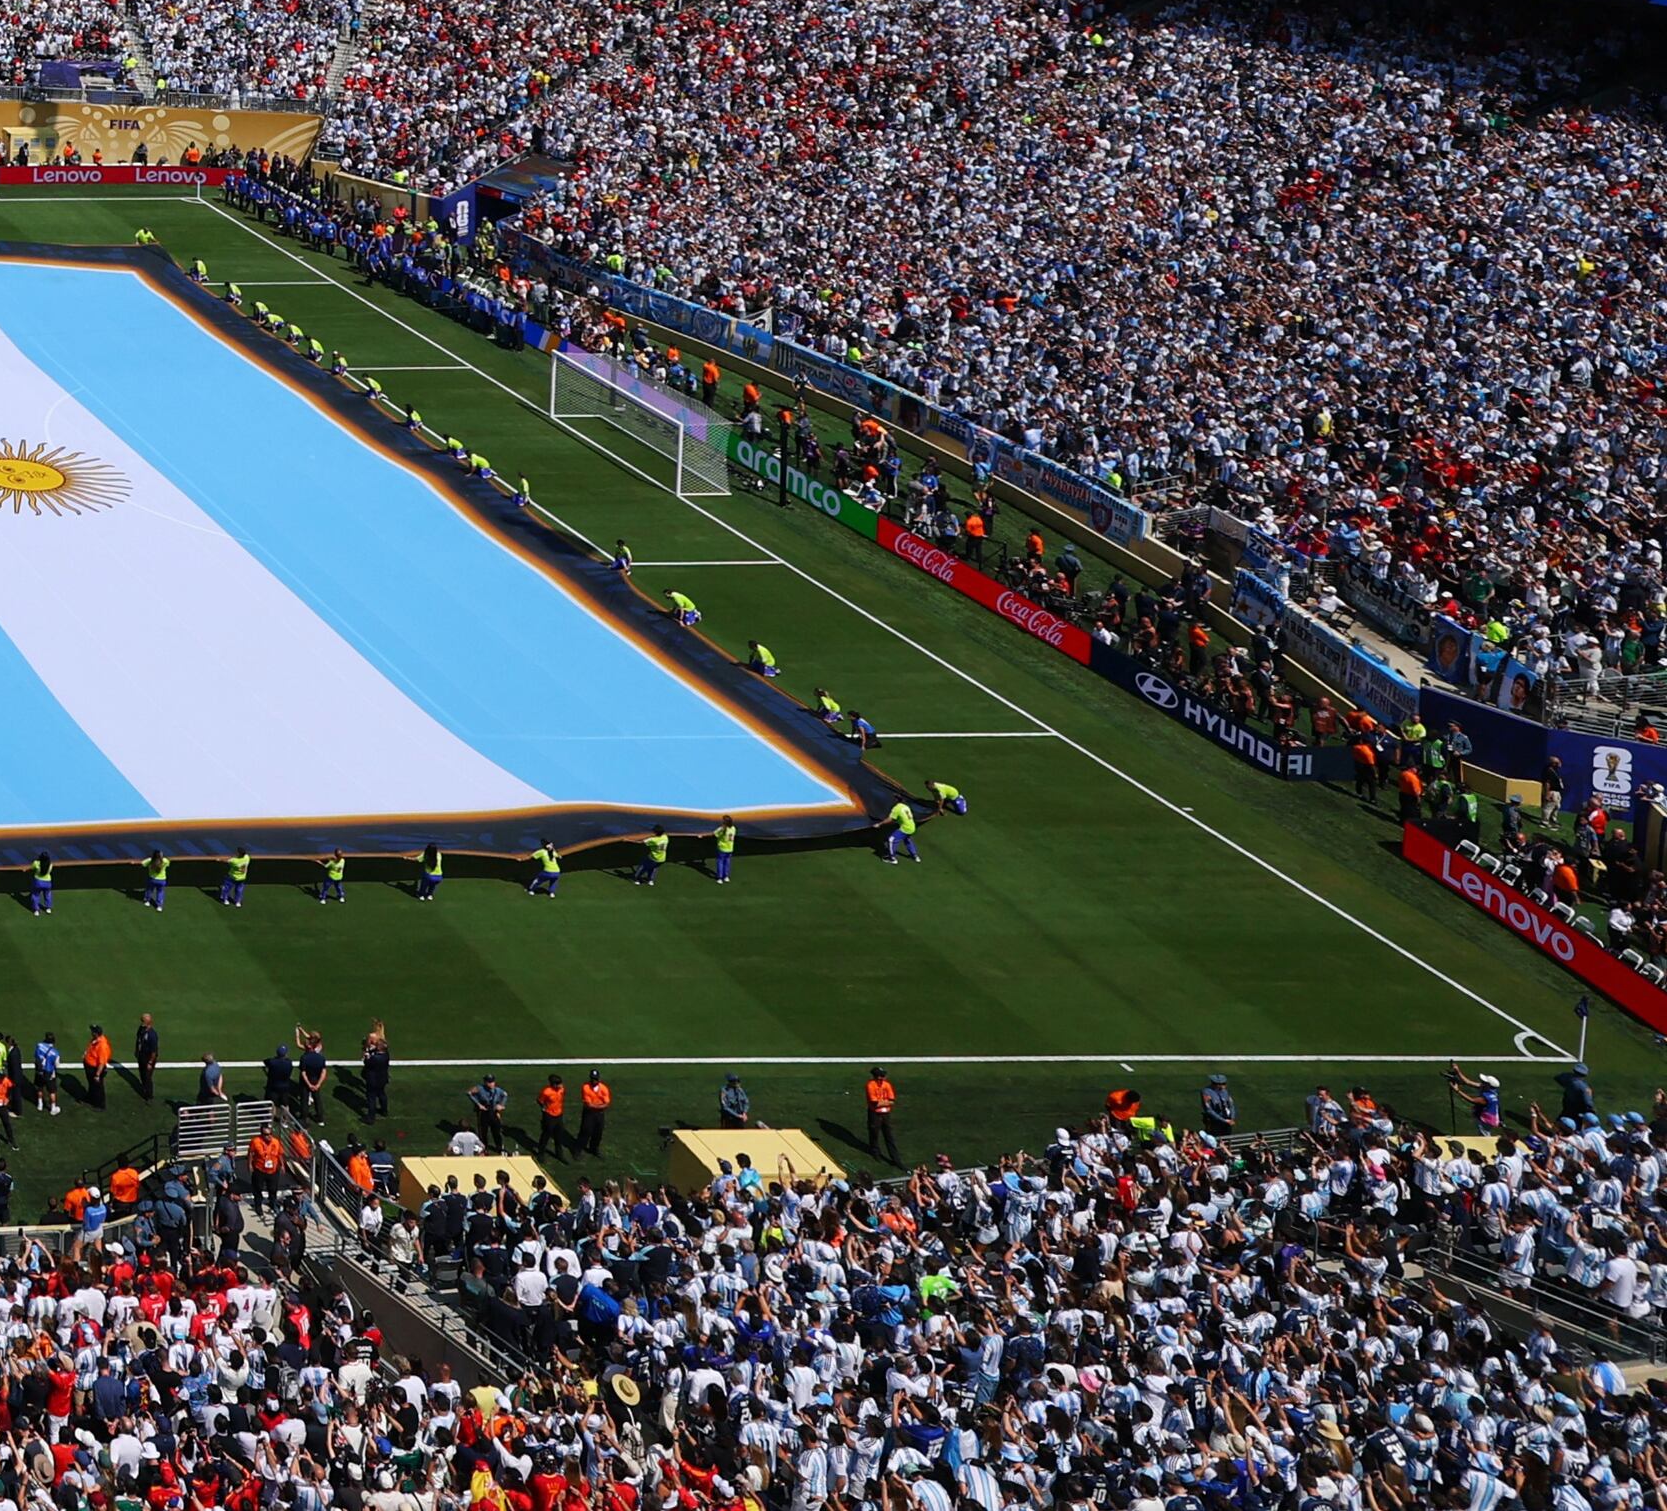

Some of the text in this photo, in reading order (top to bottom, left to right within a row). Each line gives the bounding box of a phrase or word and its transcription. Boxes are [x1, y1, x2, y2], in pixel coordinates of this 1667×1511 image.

[110, 119, 141, 130] FIFA
[33, 167, 103, 183] Lenovo
[135, 167, 207, 183] Lenovo
[736, 439, 842, 517] aramco
[894, 531, 955, 584] Coca-Cola
[996, 590, 1064, 647] Coca-Cola
[1603, 782, 1621, 790] FIFA
[1441, 850, 1576, 963] Lenovo
[243, 1299, 250, 1312] 4
